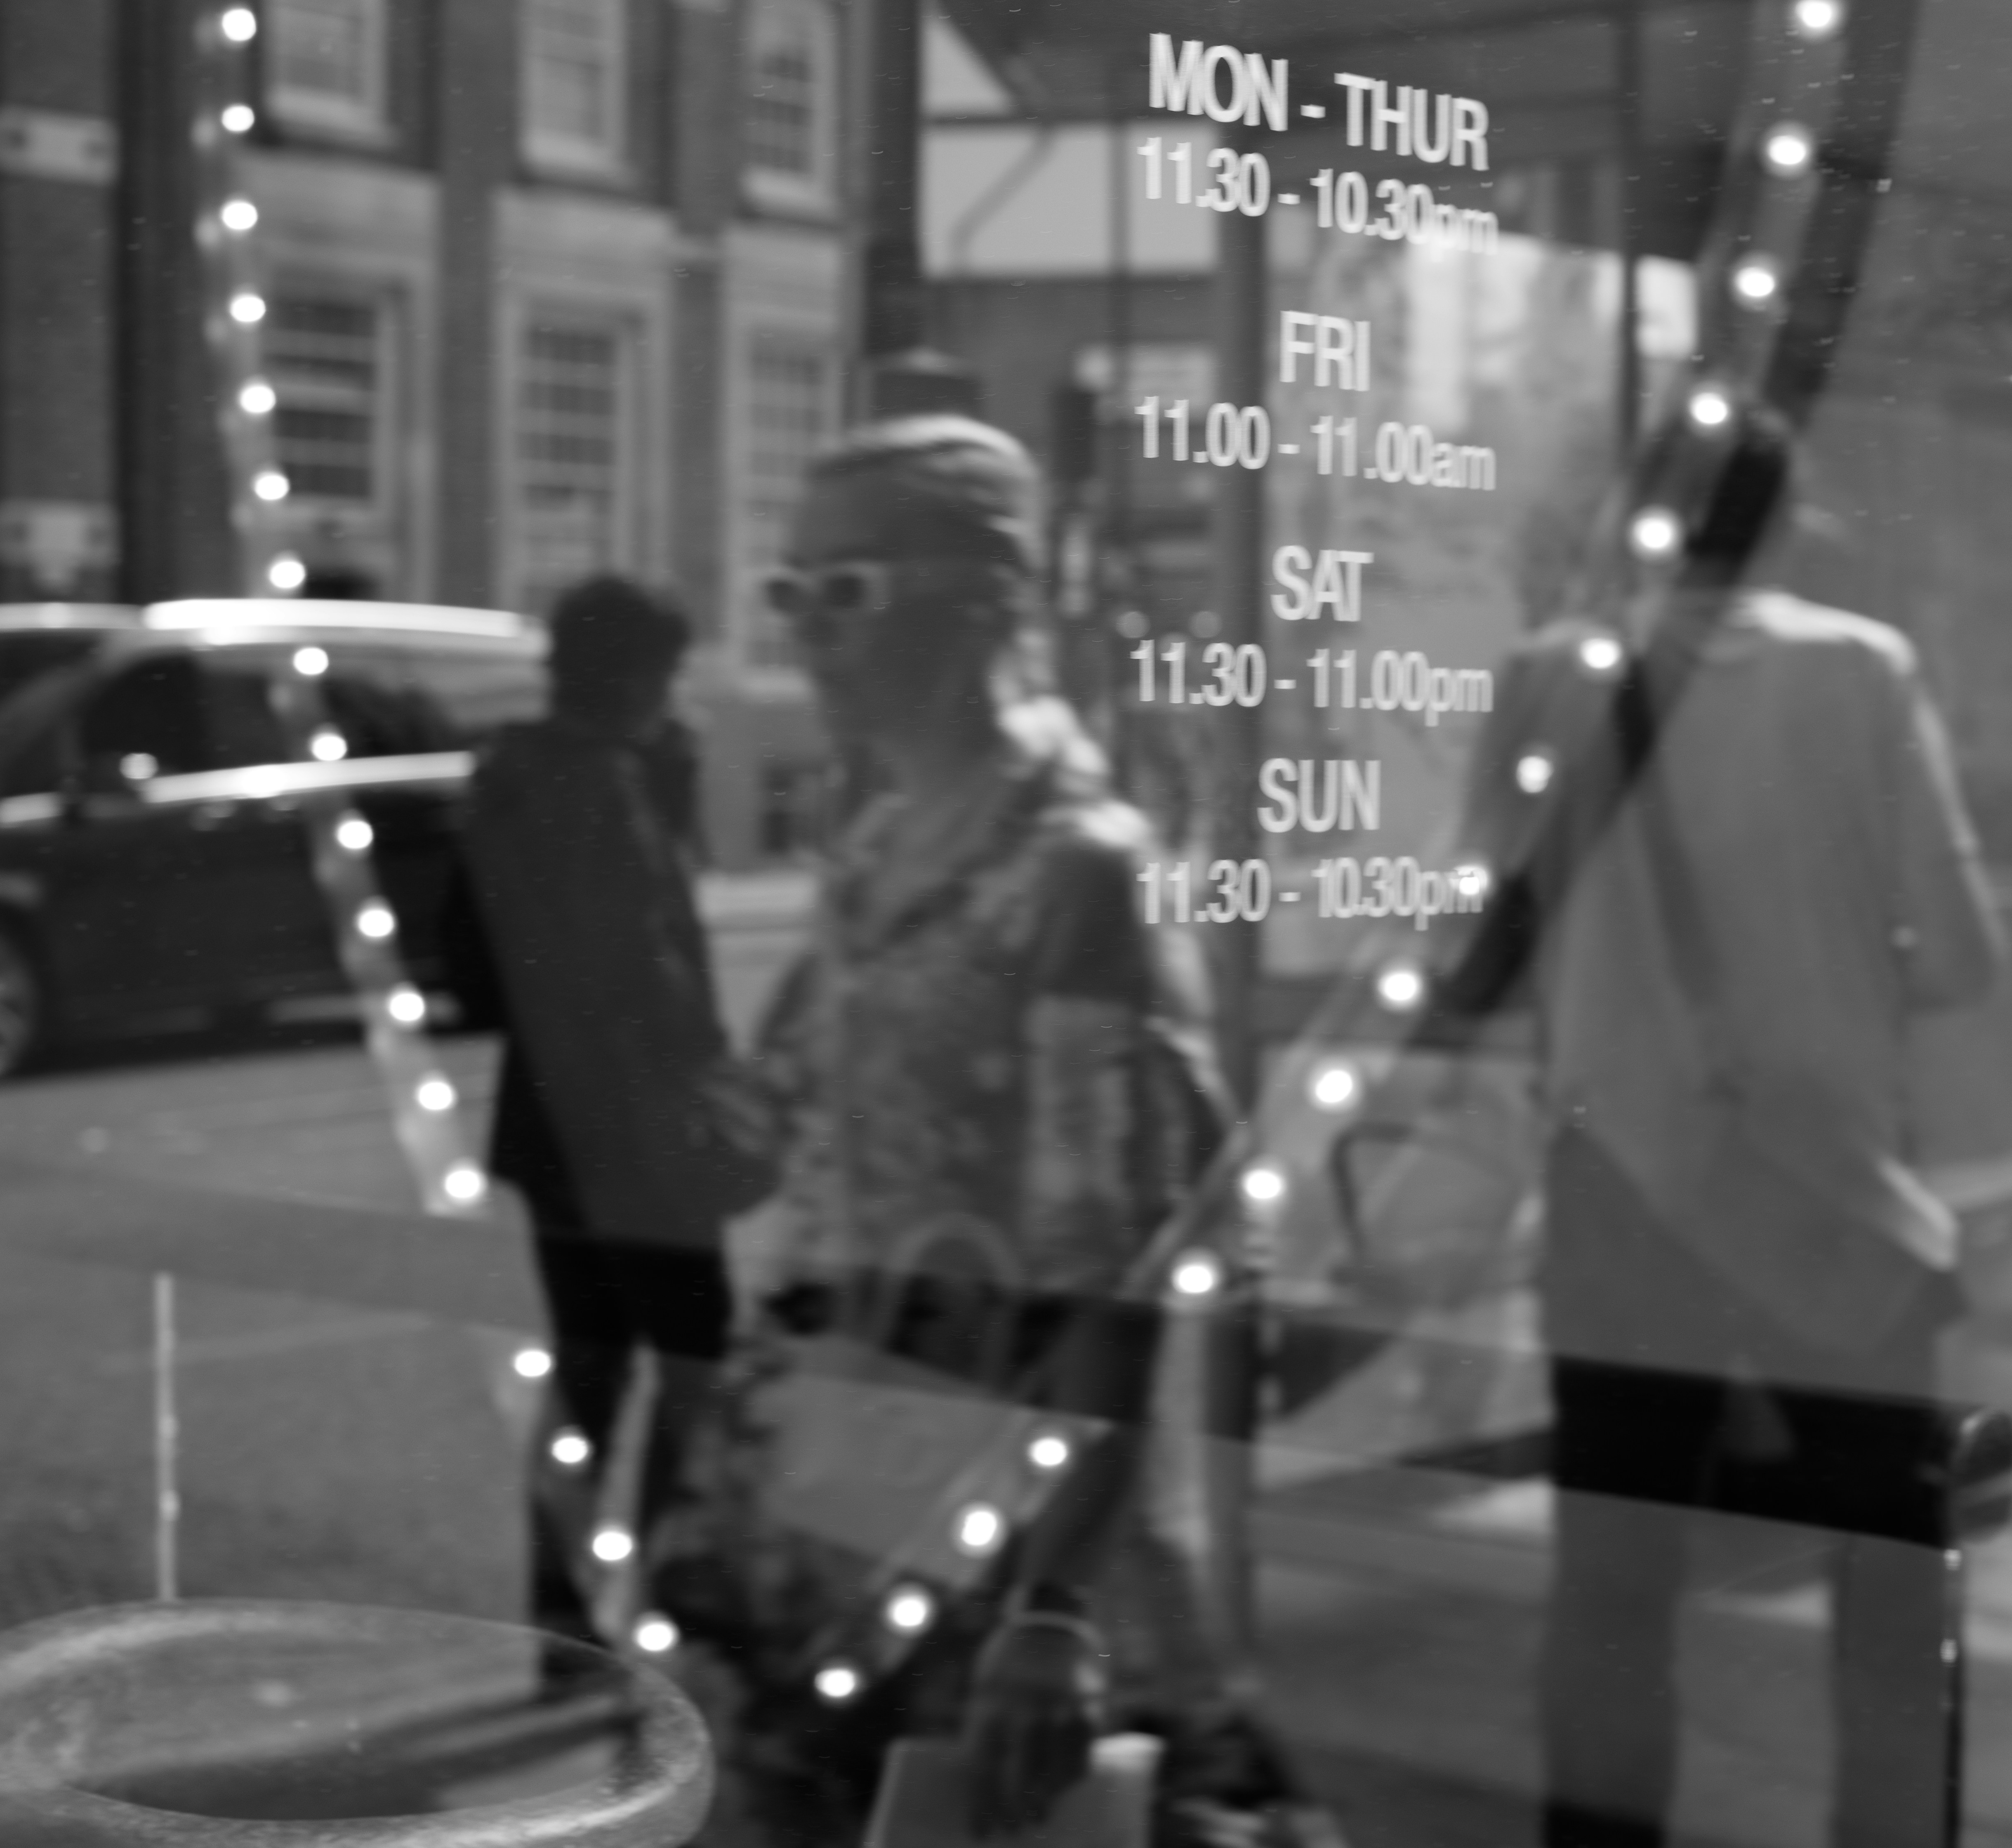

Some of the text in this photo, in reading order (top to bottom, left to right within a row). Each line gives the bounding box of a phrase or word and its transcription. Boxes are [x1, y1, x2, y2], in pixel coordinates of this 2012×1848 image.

[1149, 32, 1489, 171] MON - THUR
[1137, 137, 1498, 262] 11.30 - 10.30pm
[1279, 310, 1371, 391] FRI
[1134, 396, 1496, 490] 11.00 - 11.00am
[1270, 545, 1374, 621] SAT
[1130, 640, 1494, 727] 11.30 - 11.00pm
[1256, 758, 1381, 832] SUN
[1136, 859, 1271, 924] 11.30
[1279, 892, 1301, 902] -
